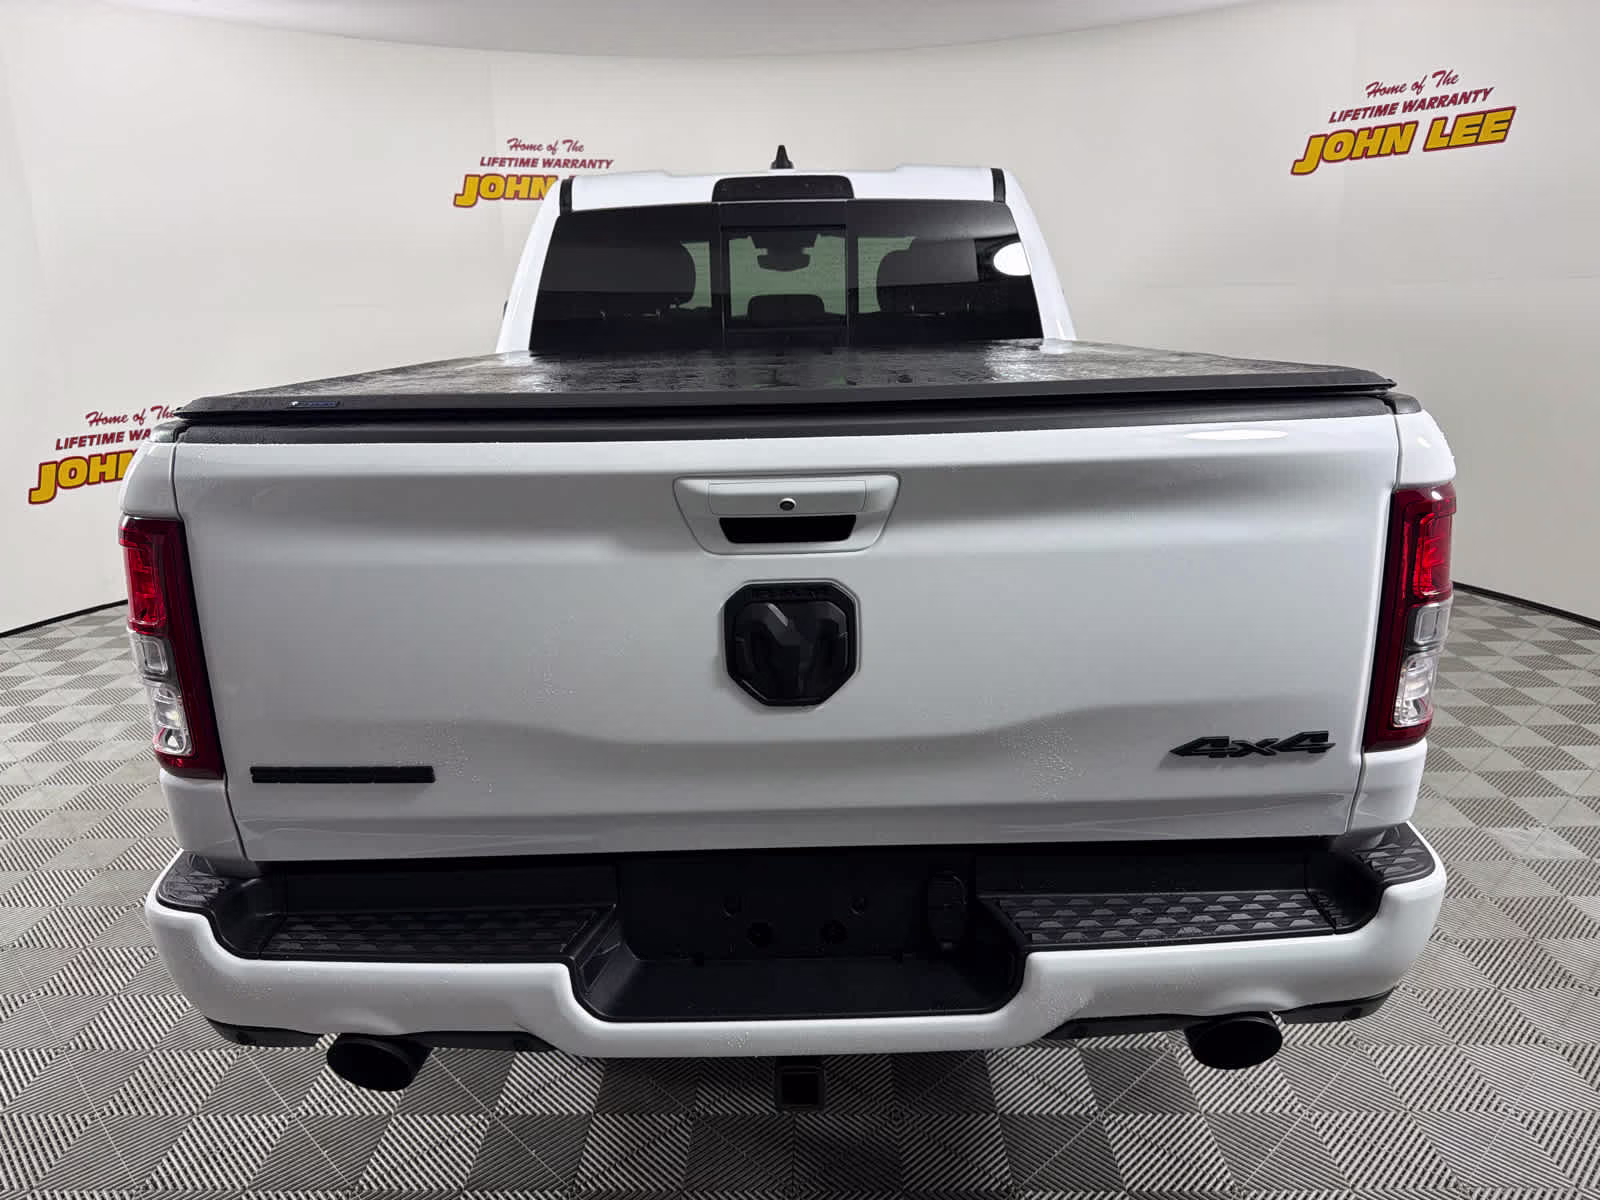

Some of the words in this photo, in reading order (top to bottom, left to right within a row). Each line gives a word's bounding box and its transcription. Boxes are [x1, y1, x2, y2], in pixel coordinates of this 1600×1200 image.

[1365, 81, 1407, 98] Home
[1411, 75, 1427, 93] of
[1432, 69, 1459, 88] The
[1328, 102, 1399, 124] LIFETIME
[1401, 87, 1495, 113] WARRANTY
[507, 138, 544, 152] Home
[546, 140, 558, 155] of
[562, 139, 585, 153] The
[1290, 120, 1419, 175] JOHN
[1423, 106, 1516, 152] LEE
[480, 156, 539, 168] LIFETIME
[542, 158, 614, 169] WARRANTY
[85, 411, 128, 427] Home
[132, 408, 146, 425] of
[55, 431, 125, 451] LIFETIME
